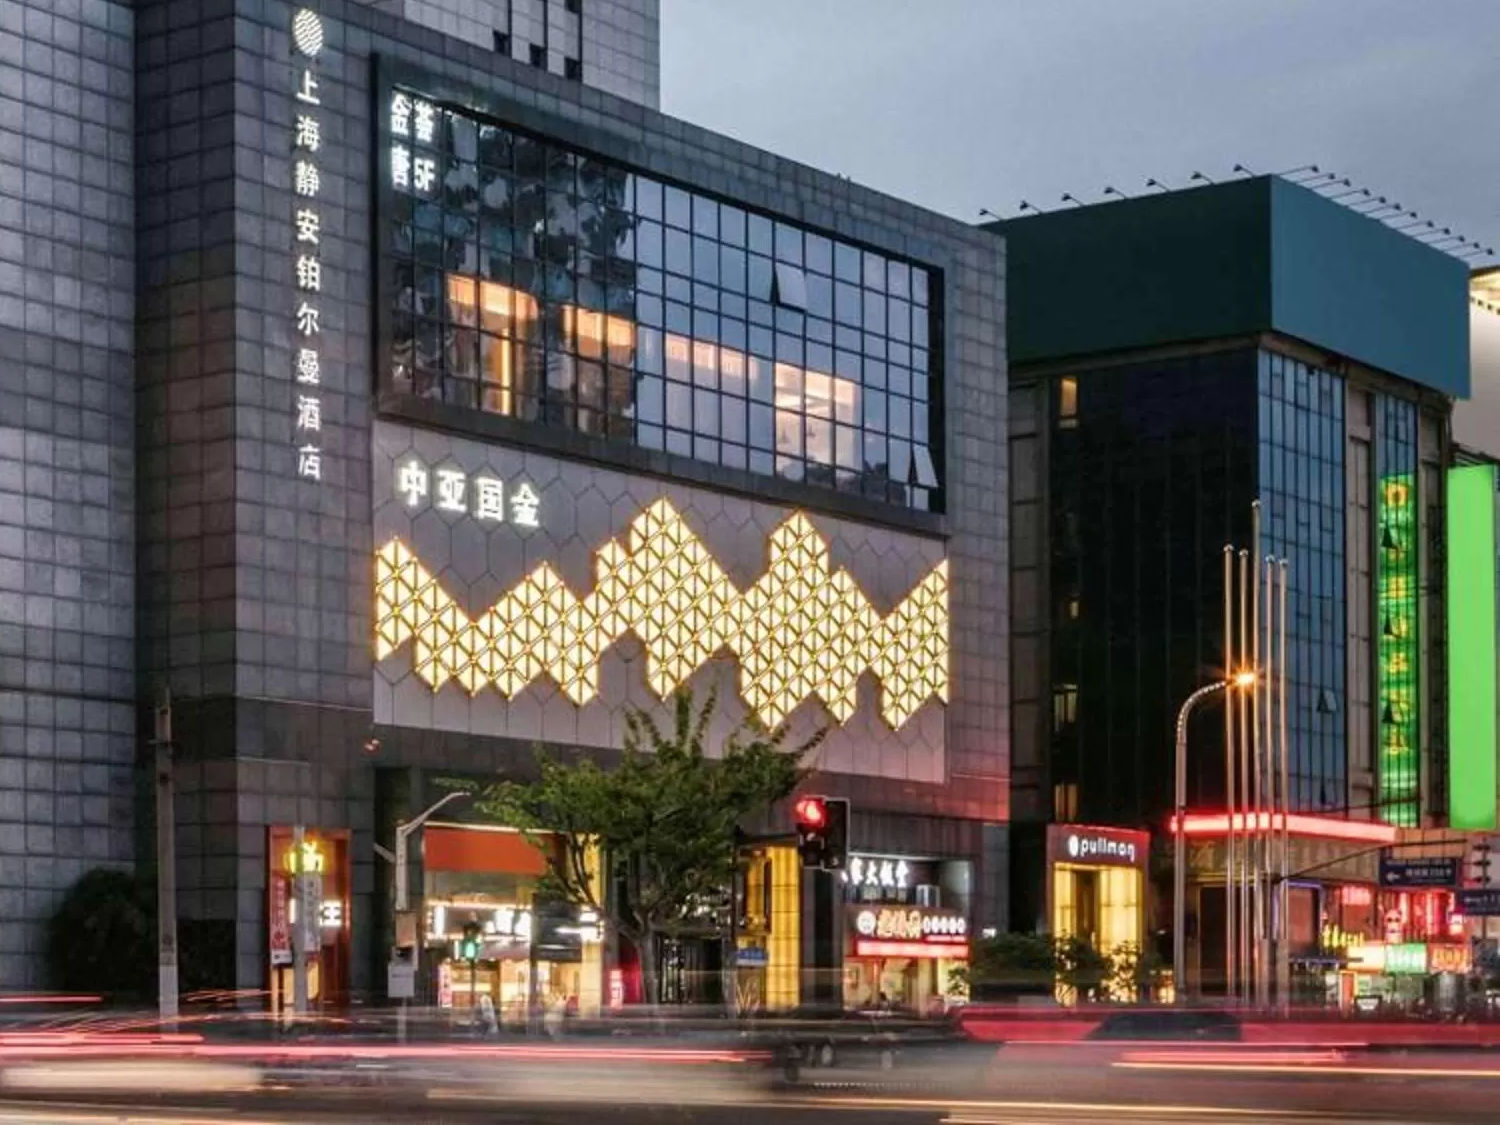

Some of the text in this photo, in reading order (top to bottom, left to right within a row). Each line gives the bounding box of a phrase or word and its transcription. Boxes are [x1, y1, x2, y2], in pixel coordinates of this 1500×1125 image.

[296, 70, 321, 480] 上海静安铂尔曼酒店
[398, 459, 541, 527] 中亚国金
[1081, 837, 1136, 863] pullman
